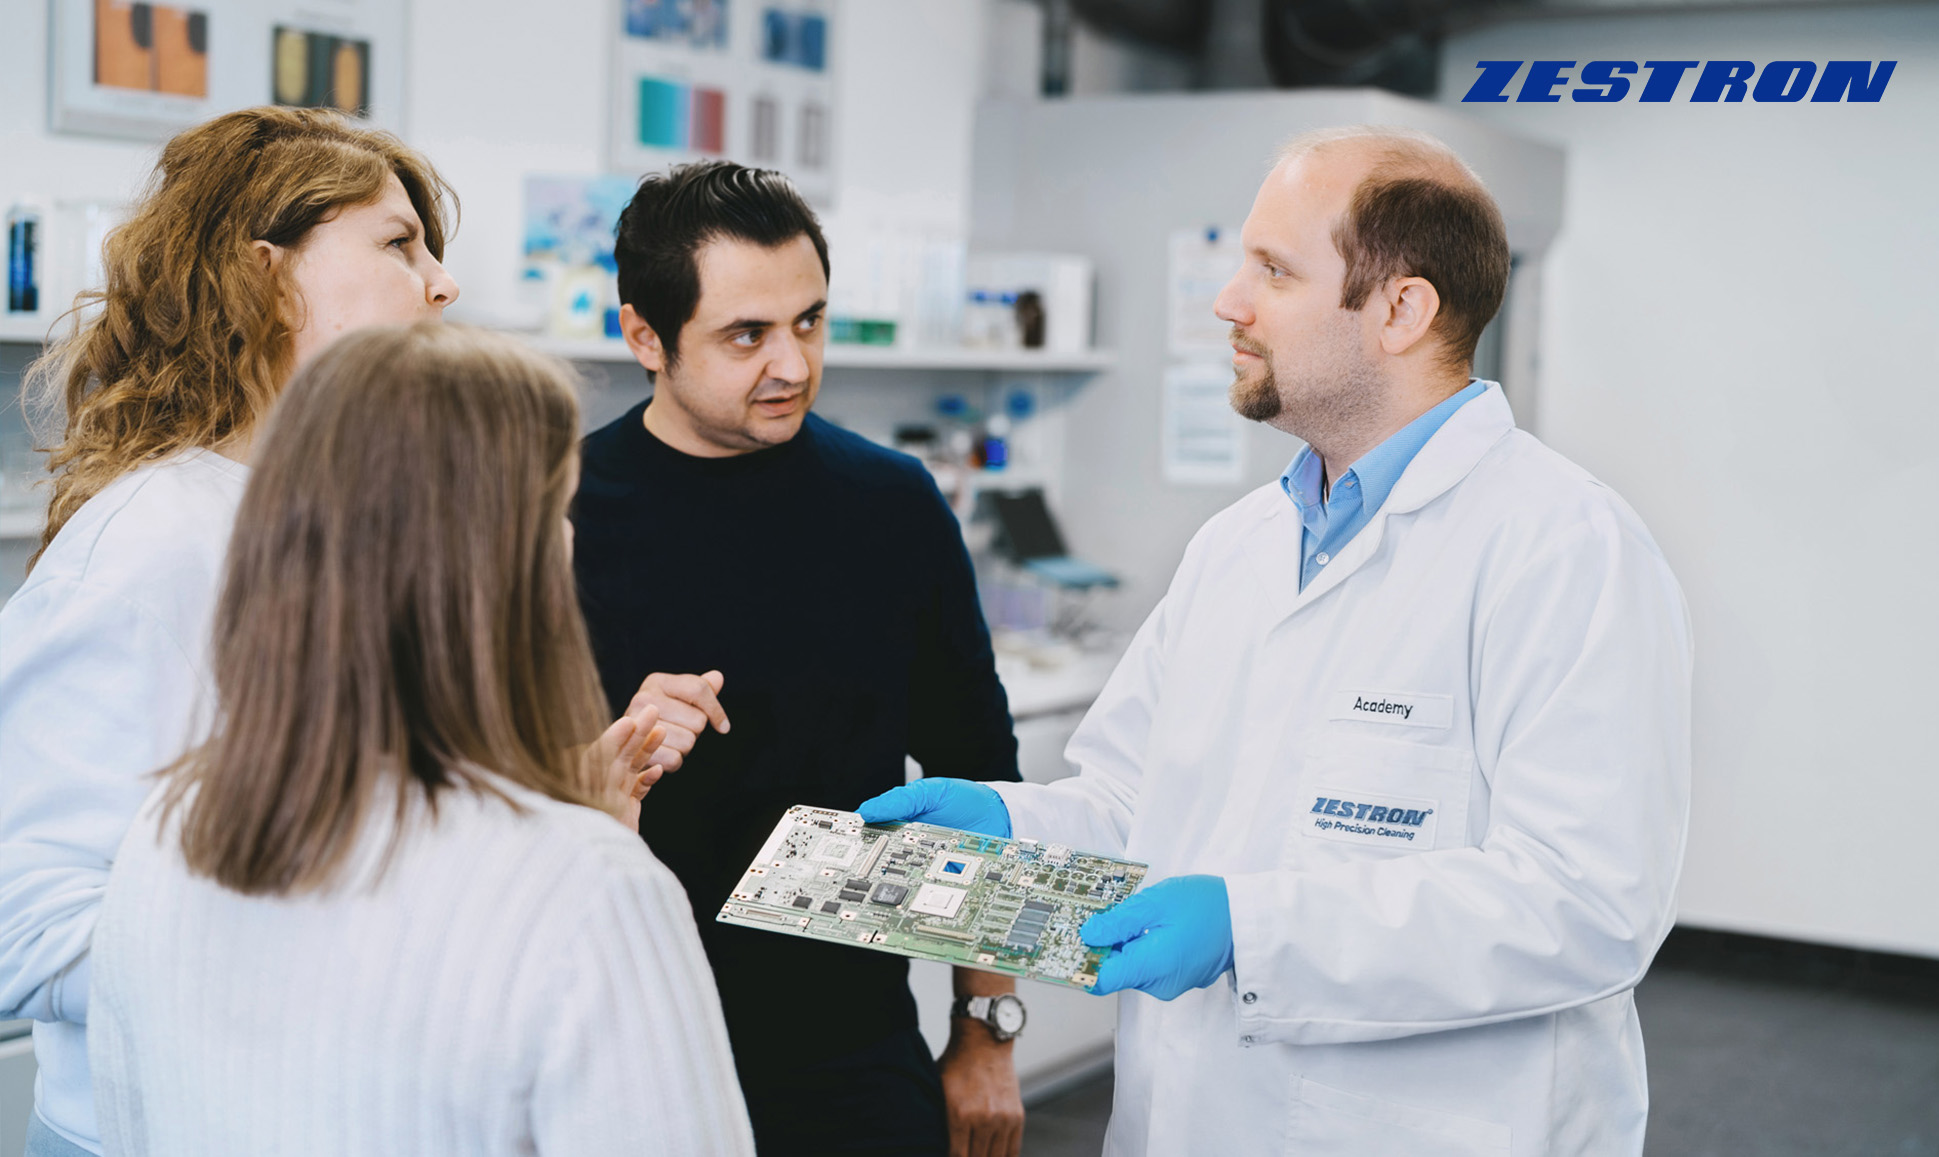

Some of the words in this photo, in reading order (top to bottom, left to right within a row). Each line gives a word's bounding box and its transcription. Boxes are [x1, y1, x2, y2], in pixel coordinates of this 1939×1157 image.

[1353, 696, 1413, 719] Academy
[1314, 818, 1332, 831] High
[1334, 822, 1375, 836] Precision
[1377, 827, 1415, 841] Cleaning
